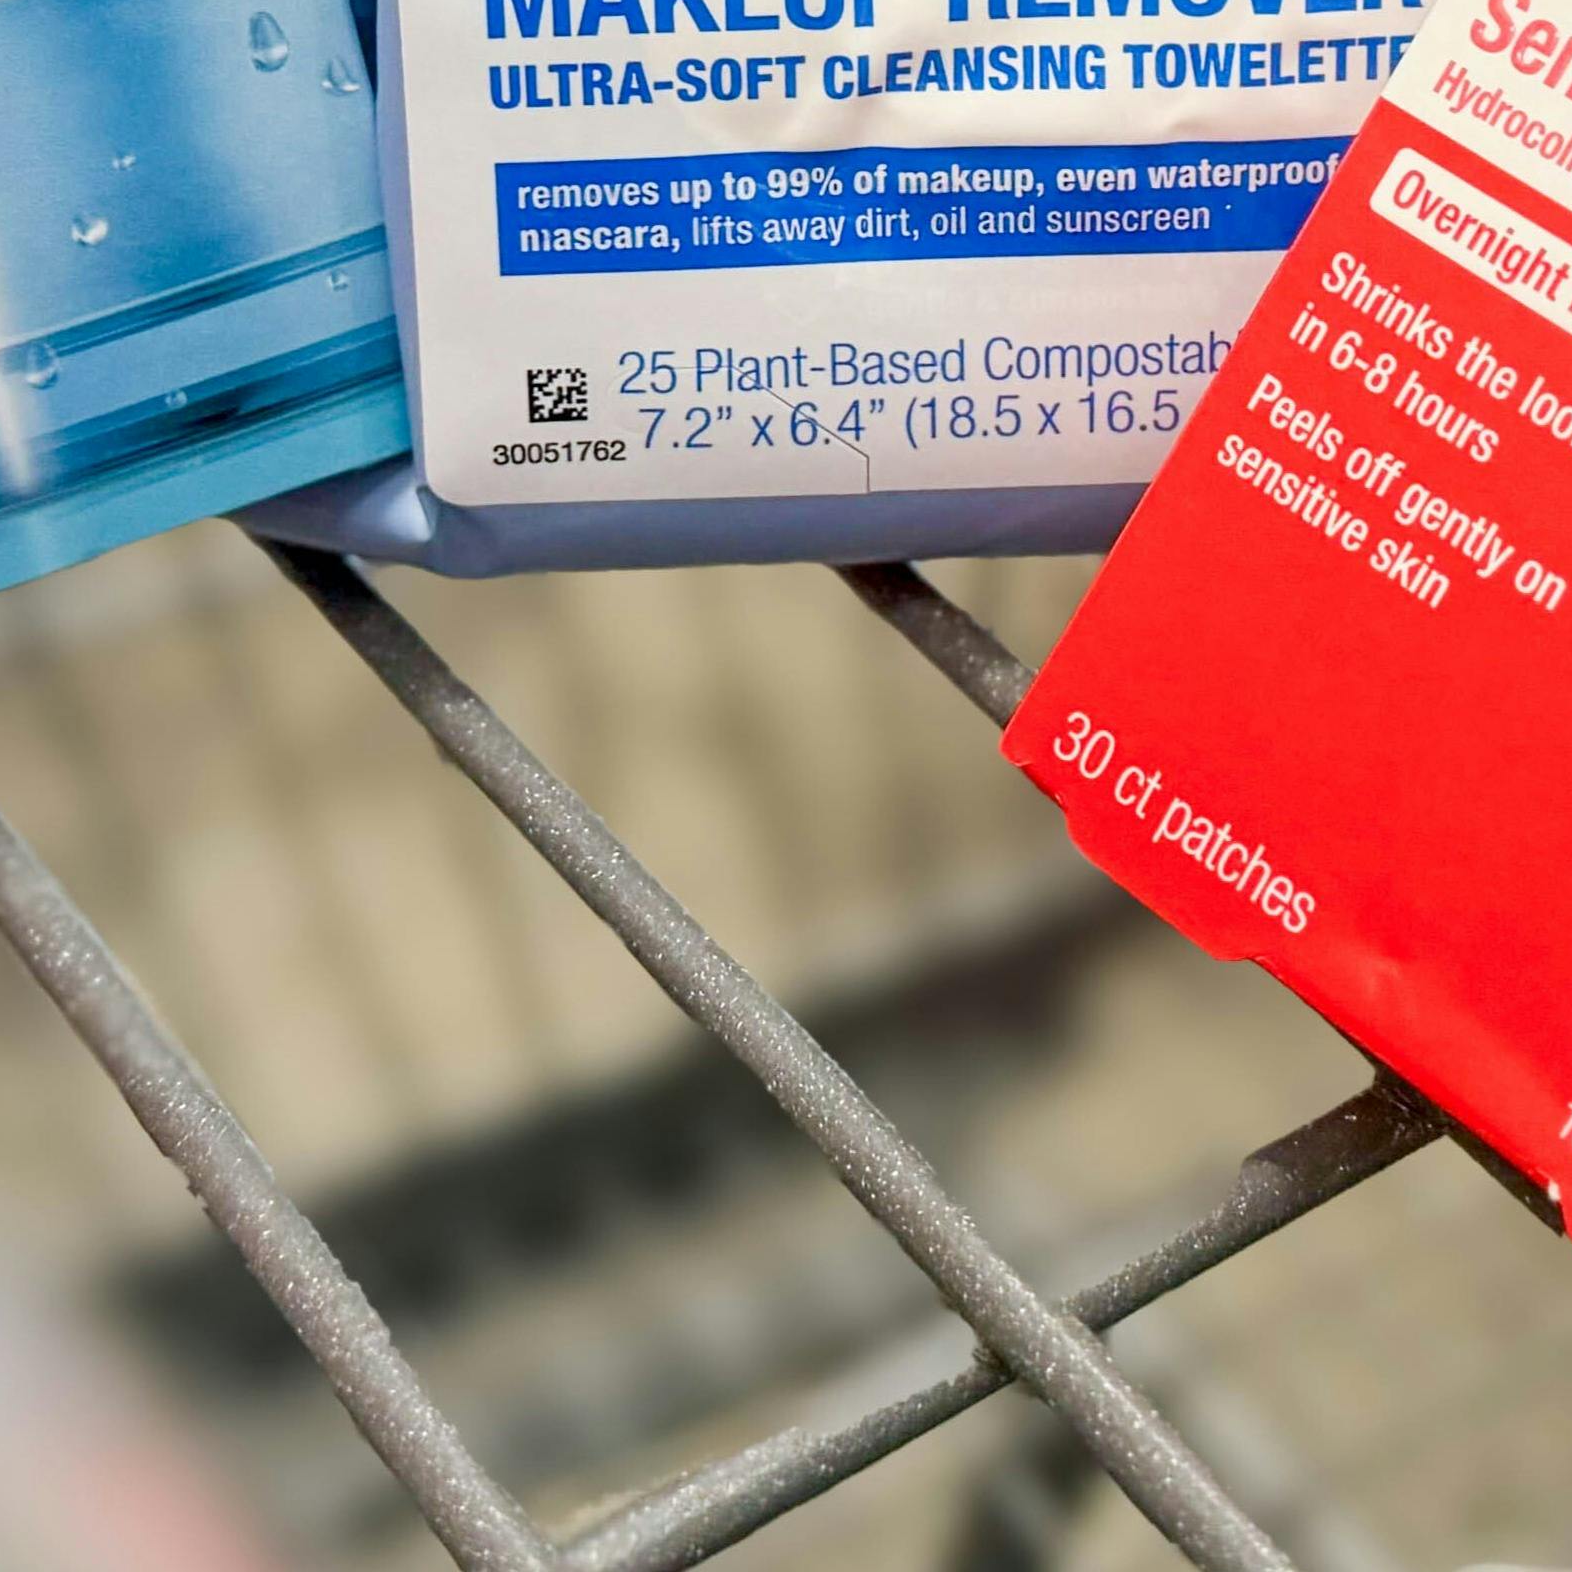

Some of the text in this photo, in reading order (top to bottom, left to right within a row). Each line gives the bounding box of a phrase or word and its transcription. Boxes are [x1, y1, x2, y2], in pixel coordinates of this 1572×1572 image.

[489, 55, 806, 109] ULTRA-SOFT
[824, 44, 1106, 100] CLEANSING
[517, 181, 659, 209] removes
[671, 179, 712, 209] up
[721, 171, 756, 202] to
[767, 166, 842, 199] 99%
[853, 164, 888, 194] of
[898, 164, 1045, 197] makeup,
[1056, 164, 1136, 192] even
[520, 205, 1210, 254] mascara, lifts away dirt, oil and sunscreen
[1392, 170, 1571, 301] Overnight
[619, 329, 1243, 394] 25 Plant-Based Compostab
[1321, 251, 1454, 361] Shrinks
[1454, 334, 1519, 402] the
[751, 414, 775, 447] x
[905, 395, 1022, 448] (18.5
[1036, 403, 1061, 436] x
[1078, 389, 1181, 433] 16.5
[1289, 301, 1500, 465] in 6-8 hours
[492, 440, 626, 466] 30051762
[1246, 373, 1568, 614] Peels off gently on
[1216, 431, 1450, 610] sensitive skin
[1053, 711, 1316, 934] 30 ct patches
